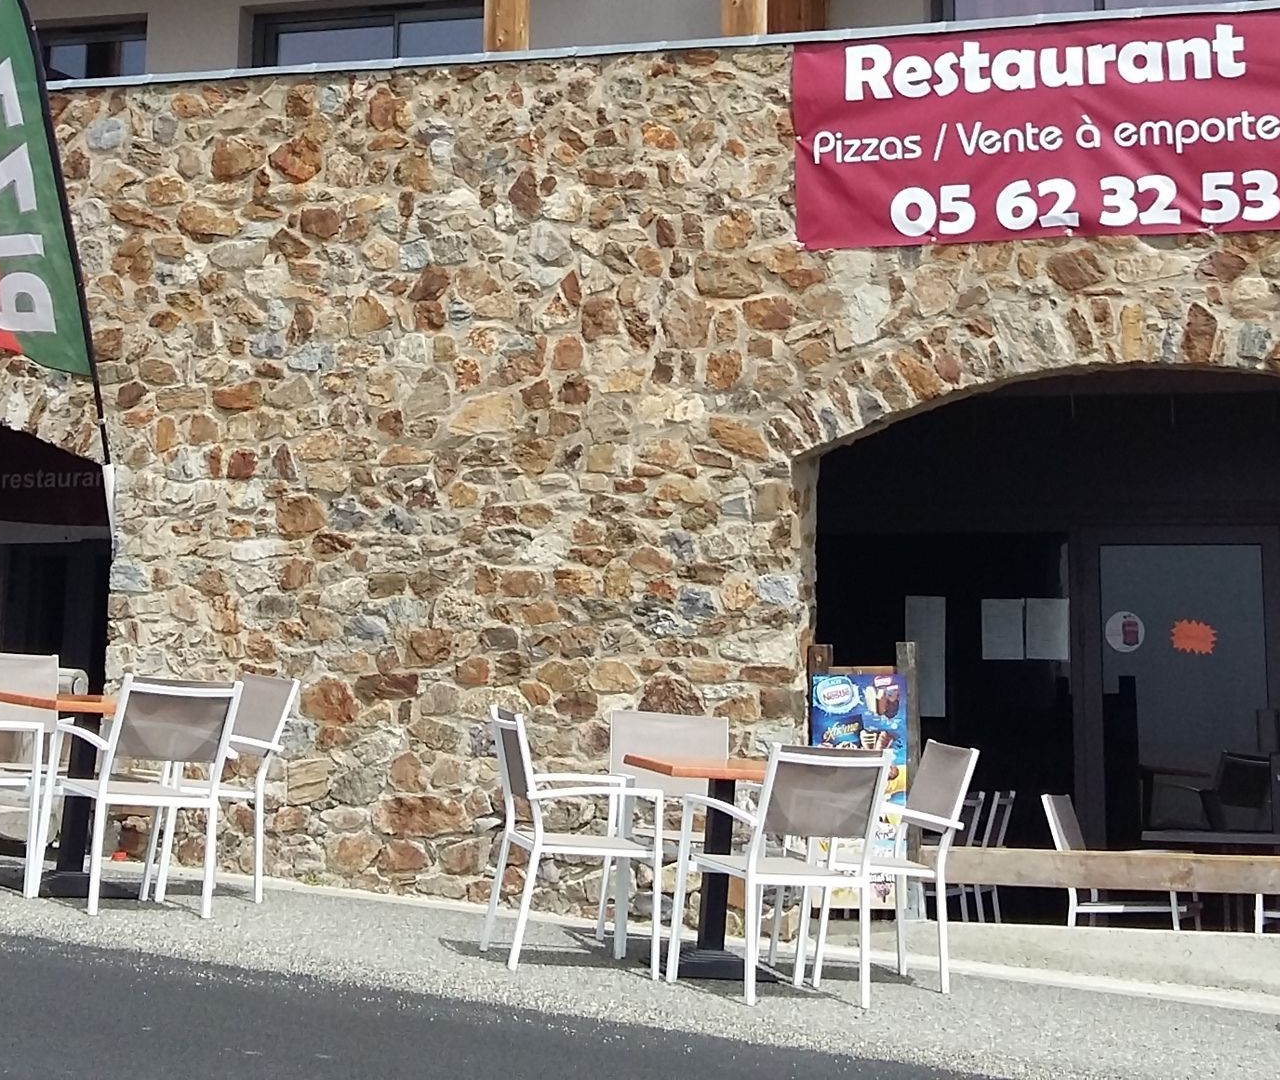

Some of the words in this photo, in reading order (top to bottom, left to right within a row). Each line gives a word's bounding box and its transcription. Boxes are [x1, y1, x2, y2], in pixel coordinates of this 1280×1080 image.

[844, 23, 1247, 102] Restaurant
[813, 130, 923, 165] Pizzas
[956, 119, 1064, 157] Vente
[1075, 114, 1102, 150] à
[890, 183, 976, 238] 05
[995, 177, 1080, 231] 62
[1099, 173, 1182, 226] 32
